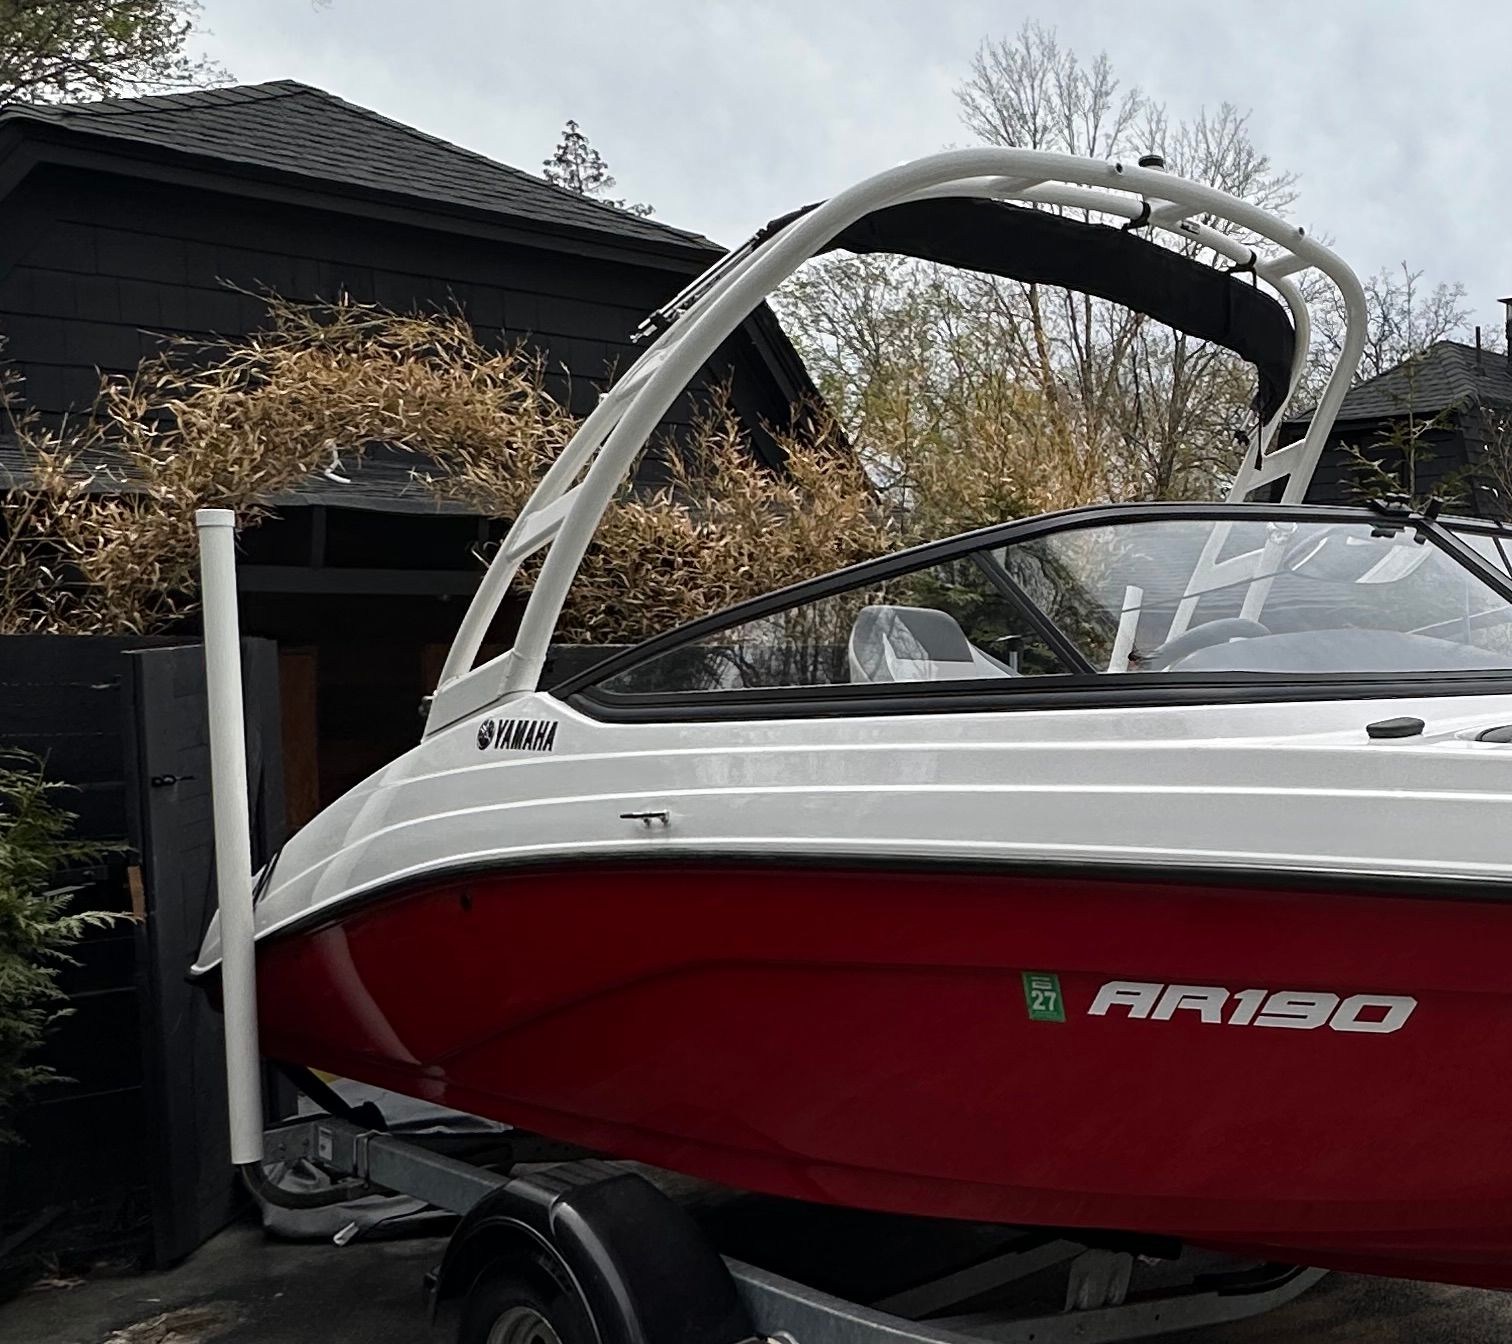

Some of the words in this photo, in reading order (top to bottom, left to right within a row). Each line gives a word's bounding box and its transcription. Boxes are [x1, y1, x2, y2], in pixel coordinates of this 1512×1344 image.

[494, 719, 558, 751] YAMAHA
[1031, 989, 1057, 1011] 27
[1087, 980, 1418, 1033] AR190
